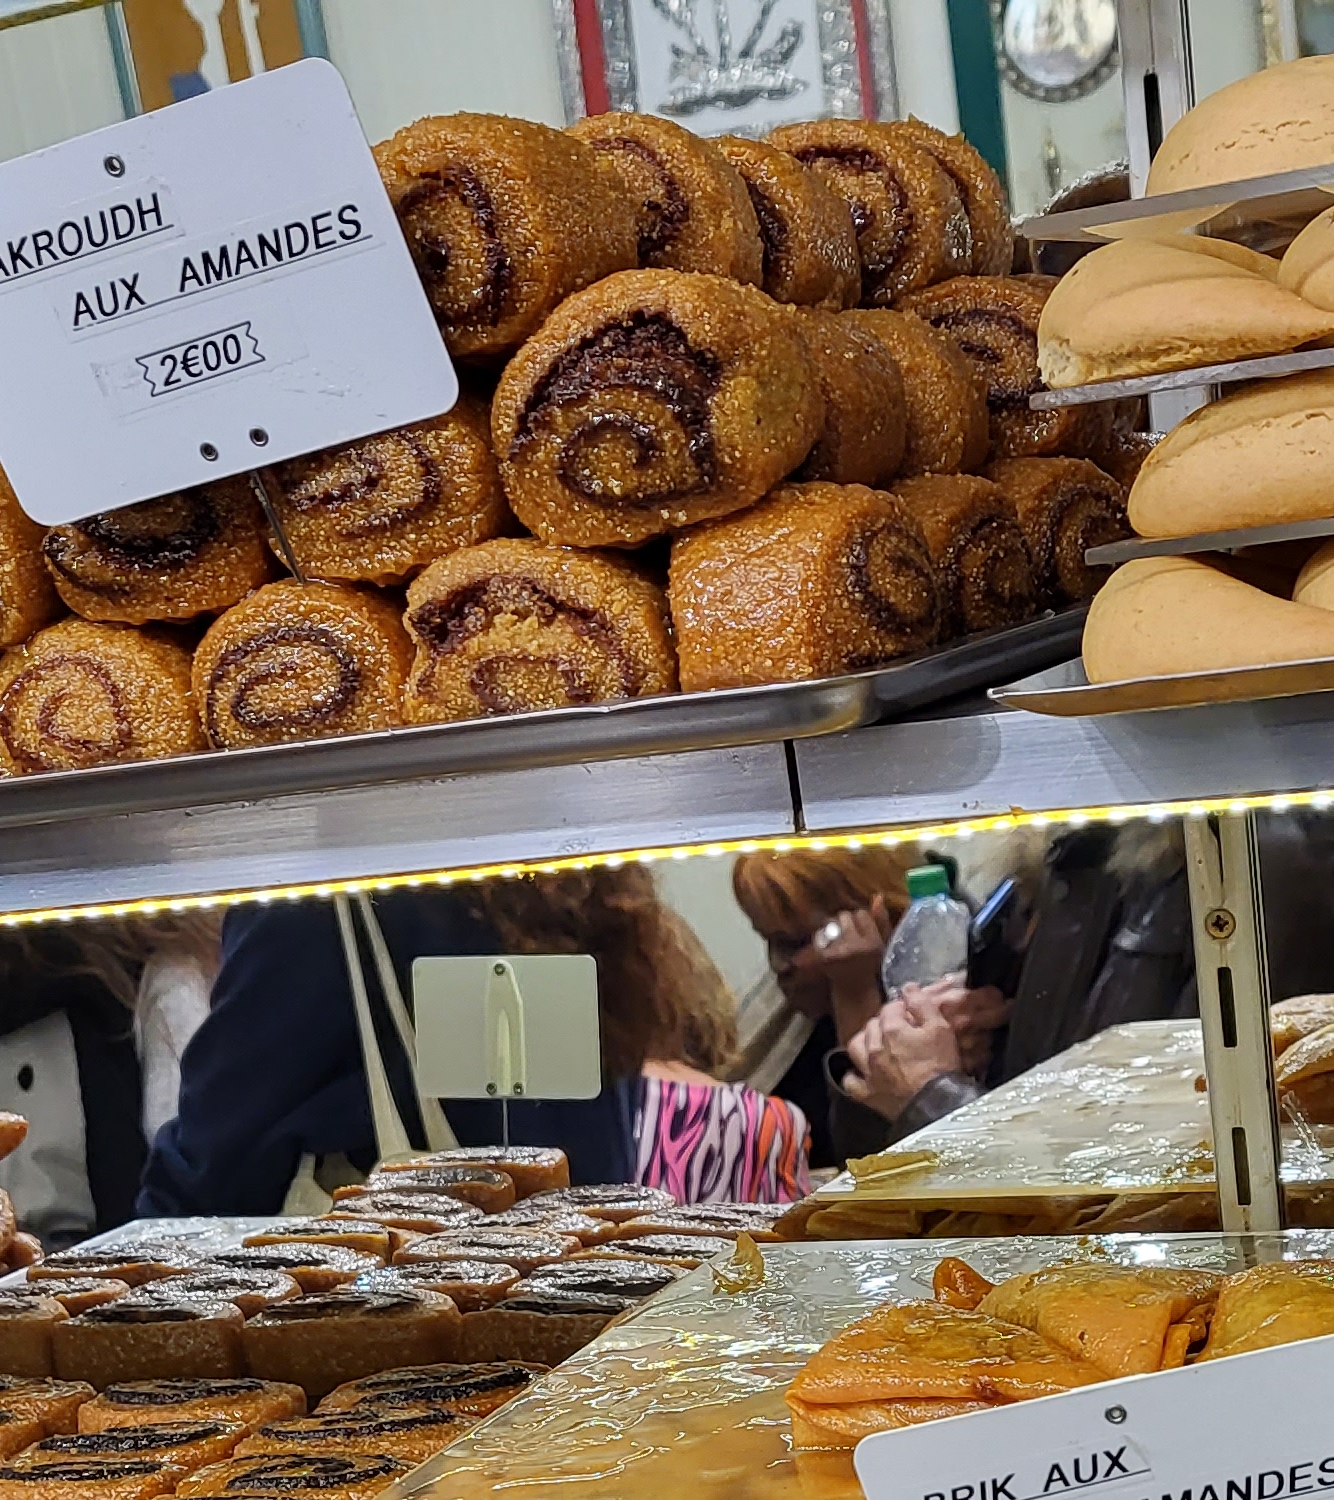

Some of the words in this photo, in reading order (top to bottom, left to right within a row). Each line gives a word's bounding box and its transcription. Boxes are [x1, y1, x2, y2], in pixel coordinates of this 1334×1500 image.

[72, 272, 146, 327] AUX
[178, 204, 363, 293] AMANDES
[159, 333, 242, 388] 2€00
[1043, 1446, 1129, 1493] AUX
